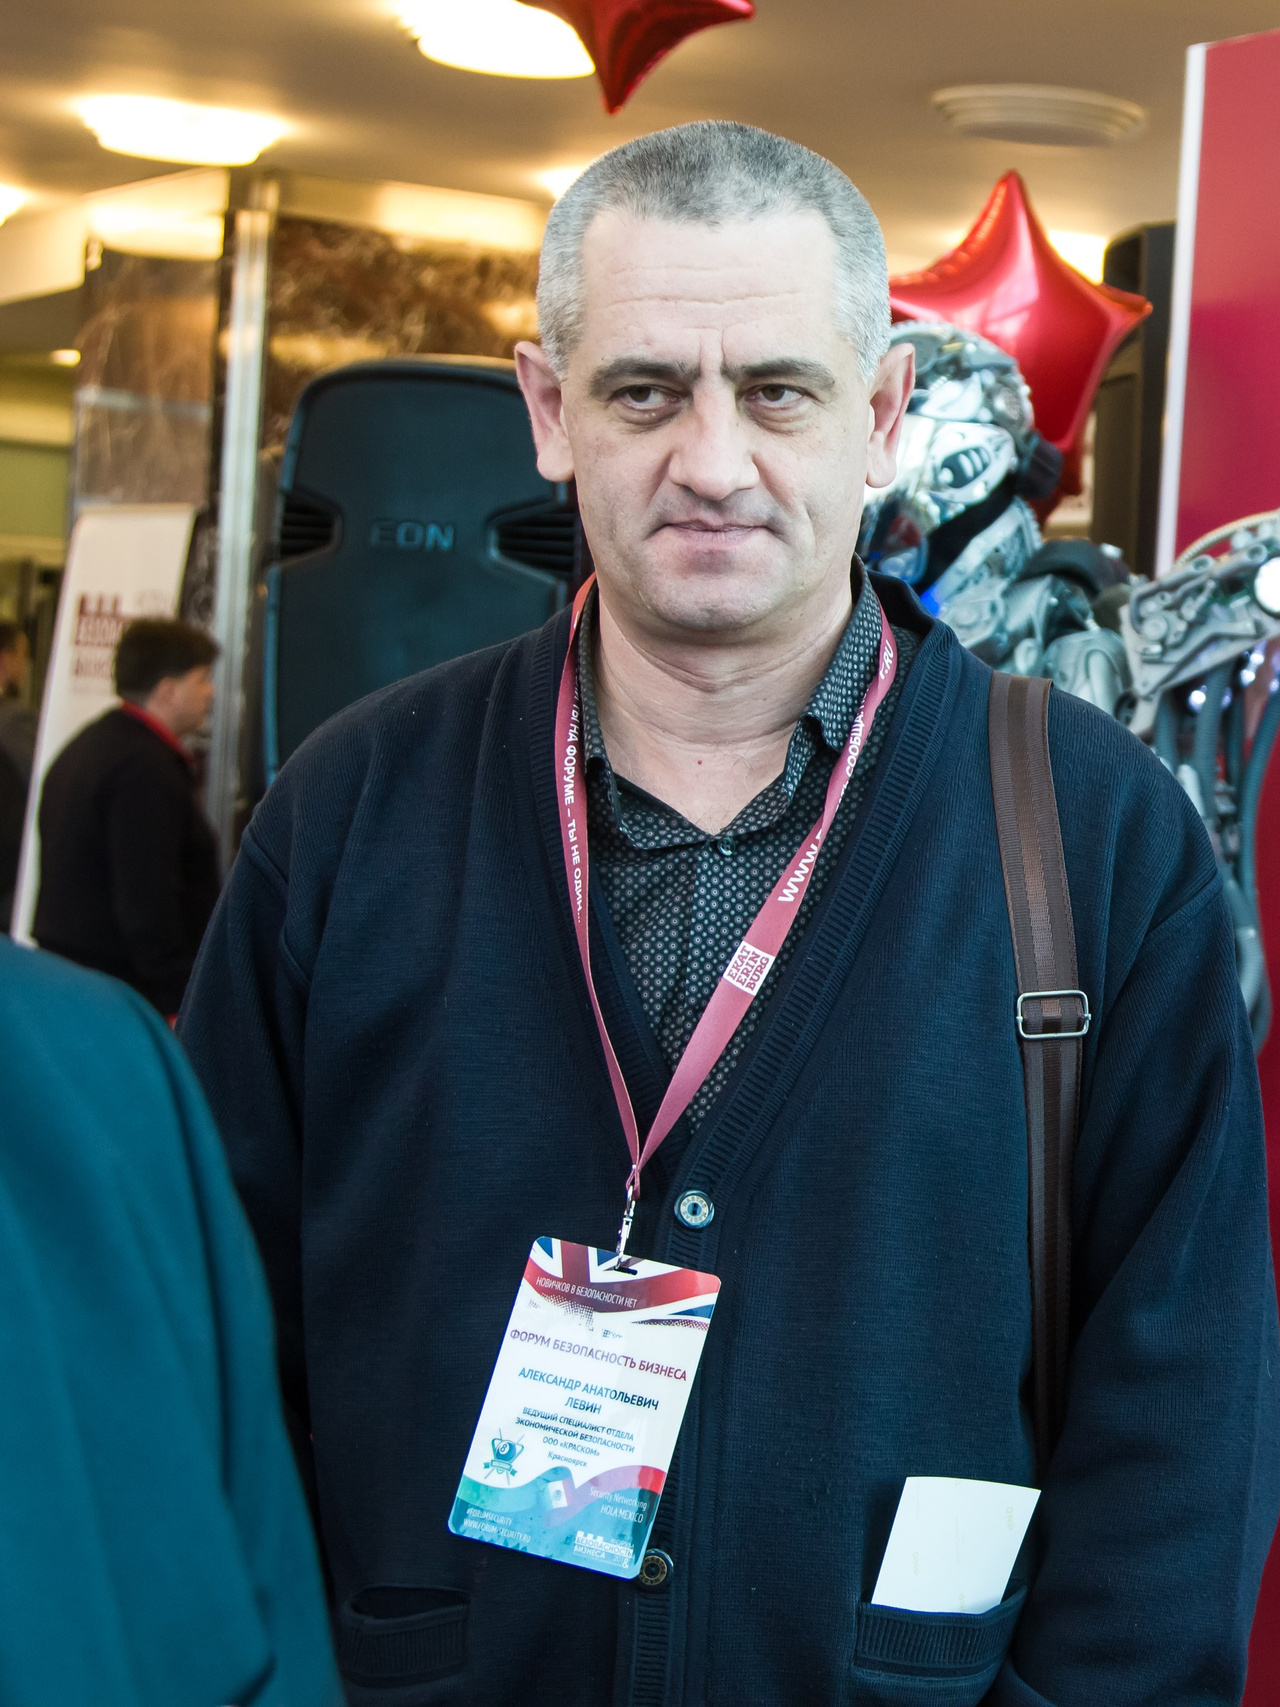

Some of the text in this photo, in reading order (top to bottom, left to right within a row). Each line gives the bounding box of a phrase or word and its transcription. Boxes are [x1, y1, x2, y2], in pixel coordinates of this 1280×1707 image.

[567, 723, 580, 742] НА
[564, 745, 577, 806] ФОРУМЕ
[567, 819, 578, 842] ТЫ
[571, 844, 581, 865] НЕ
[727, 945, 751, 981] EKAT
[736, 951, 761, 986] ERIN
[745, 956, 770, 991] BURG
[535, 1276, 571, 1293] НОВИЧКОВ
[575, 1285, 625, 1305] БЕЗОПАСНОСТИ
[623, 1298, 638, 1309] НЕТ
[510, 1328, 687, 1381] ФОРУМ БЕЗОПАСНОСТЬ БИЗНЕСА
[518, 1367, 660, 1411] АЛЕКСАНДР АНАТОЛЬЕВИЧ
[564, 1396, 602, 1415] ЛЕВИН
[515, 1416, 635, 1454] ЭКОНОМИЧЕСКОЙ БЕЗОПАСНОСТИ
[522, 1406, 635, 1442] ВЕДУЩИЙ СПЕЦИАЛИСТ ОТДЕЛА
[542, 1435, 600, 1457] ООО «КРАСКОМ»
[547, 1451, 588, 1468] Красноярск
[590, 1486, 648, 1512] Security Networking
[600, 1504, 644, 1524] HOLA MEXICO
[574, 1545, 606, 1559] БИЗНЕСА
[576, 1537, 633, 1557] БЕЗОПАСНОСТЬ
